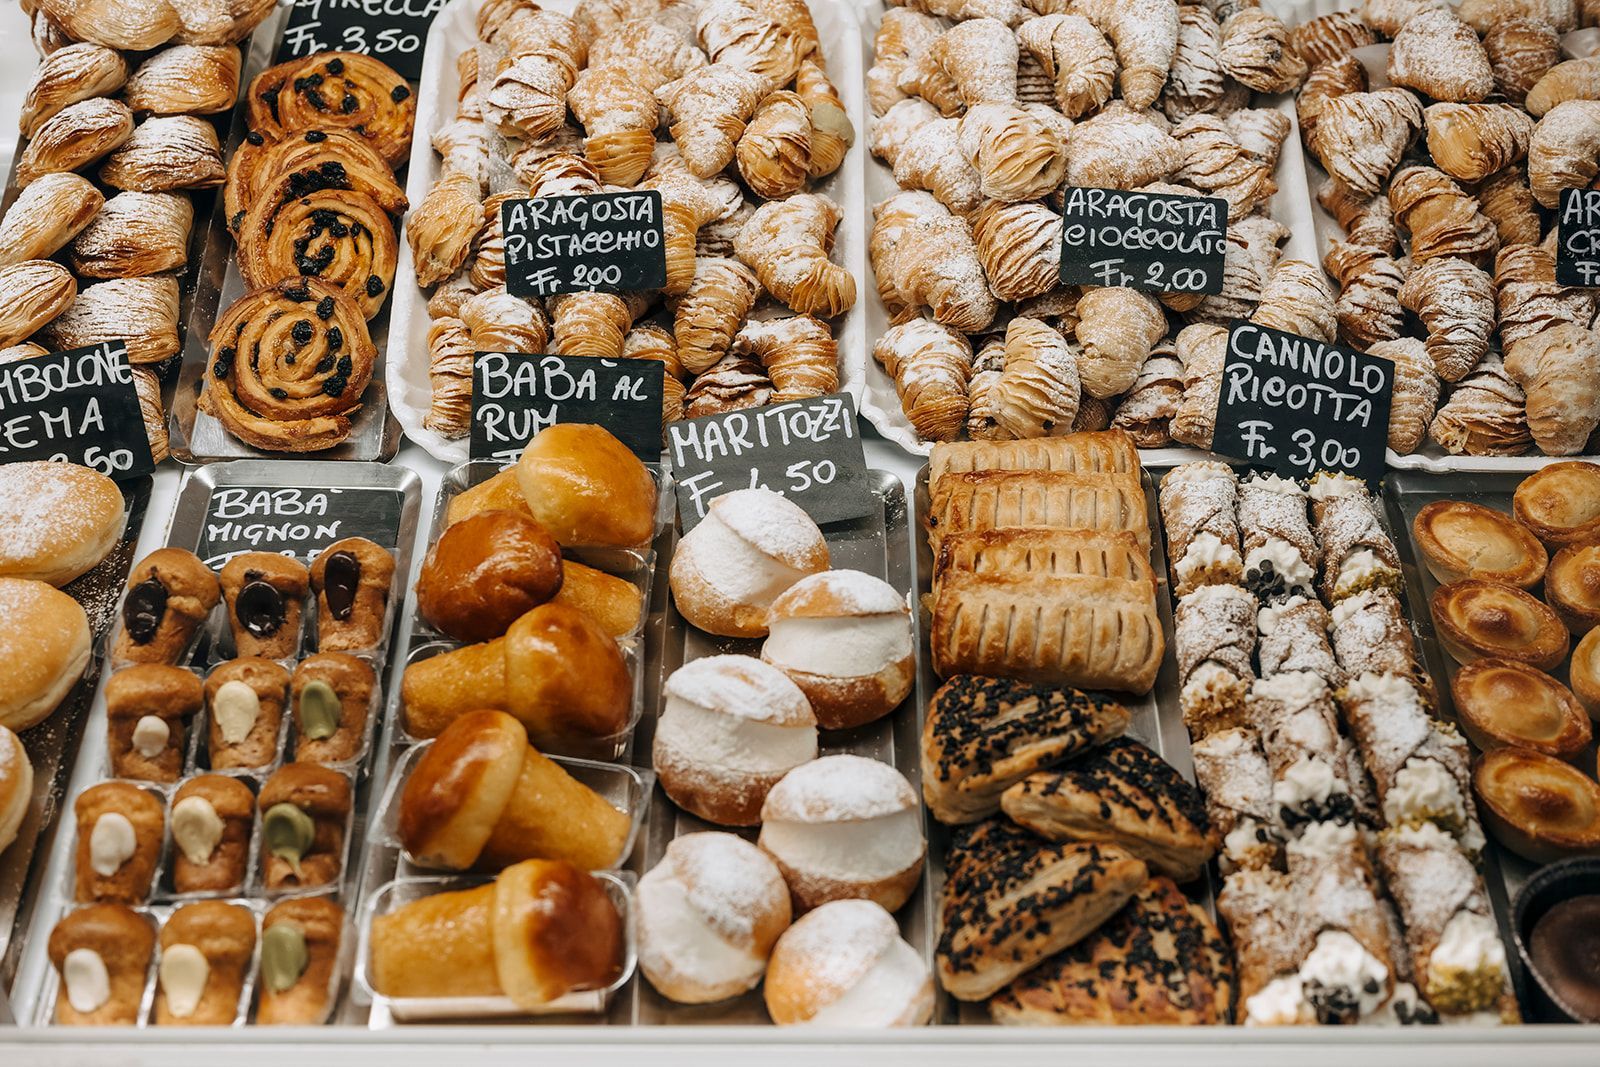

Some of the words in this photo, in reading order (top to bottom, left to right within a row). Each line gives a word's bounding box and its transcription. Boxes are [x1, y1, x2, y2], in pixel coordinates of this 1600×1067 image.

[284, 21, 328, 56] Fr
[508, 196, 654, 232] ARAGOSTA
[1067, 188, 1217, 228] ARAGOSTA
[525, 267, 562, 295] Fr
[1089, 258, 1135, 287] Fr
[1144, 261, 1208, 292] 2,00
[1230, 325, 1385, 394] CANNOLO
[612, 375, 648, 401] AL
[1225, 362, 1373, 428] RICOTTA
[0, 397, 105, 448] EMA
[476, 403, 559, 442] RUM
[670, 399, 853, 467] MARITOZZI
[1238, 420, 1278, 459] Fr
[1288, 428, 1361, 474] 3,00
[207, 520, 342, 545] MIGNON
